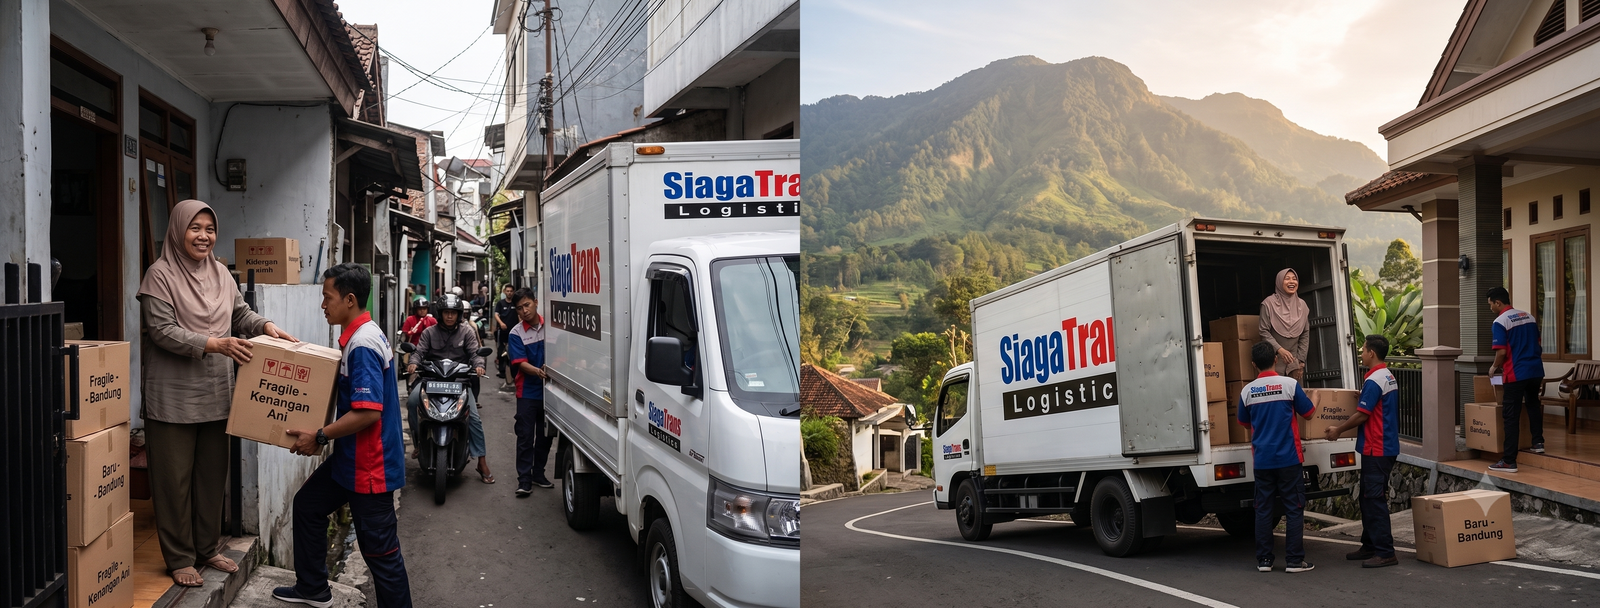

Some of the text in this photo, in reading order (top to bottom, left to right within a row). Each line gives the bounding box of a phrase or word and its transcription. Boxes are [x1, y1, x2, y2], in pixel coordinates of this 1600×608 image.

[679, 202, 799, 217] Logisti
[549, 242, 601, 298] SiagaTrans
[552, 304, 597, 332] Logistics
[89, 372, 114, 388] Fragile
[259, 378, 299, 397] Fragile
[90, 388, 122, 404] Bandung
[250, 390, 310, 413] Kenangan
[1013, 380, 1114, 414] Logistic
[266, 409, 288, 422] Ani
[1323, 406, 1342, 414] Fragile
[1472, 418, 1483, 427] Baru
[1469, 425, 1491, 437] Bandung
[102, 462, 117, 478] Baru
[98, 473, 124, 500] Bandung
[1464, 519, 1488, 530] Baru
[1457, 529, 1503, 543] Bandung
[97, 561, 119, 584] Fragile
[88, 564, 130, 607] Kenangan Ani
